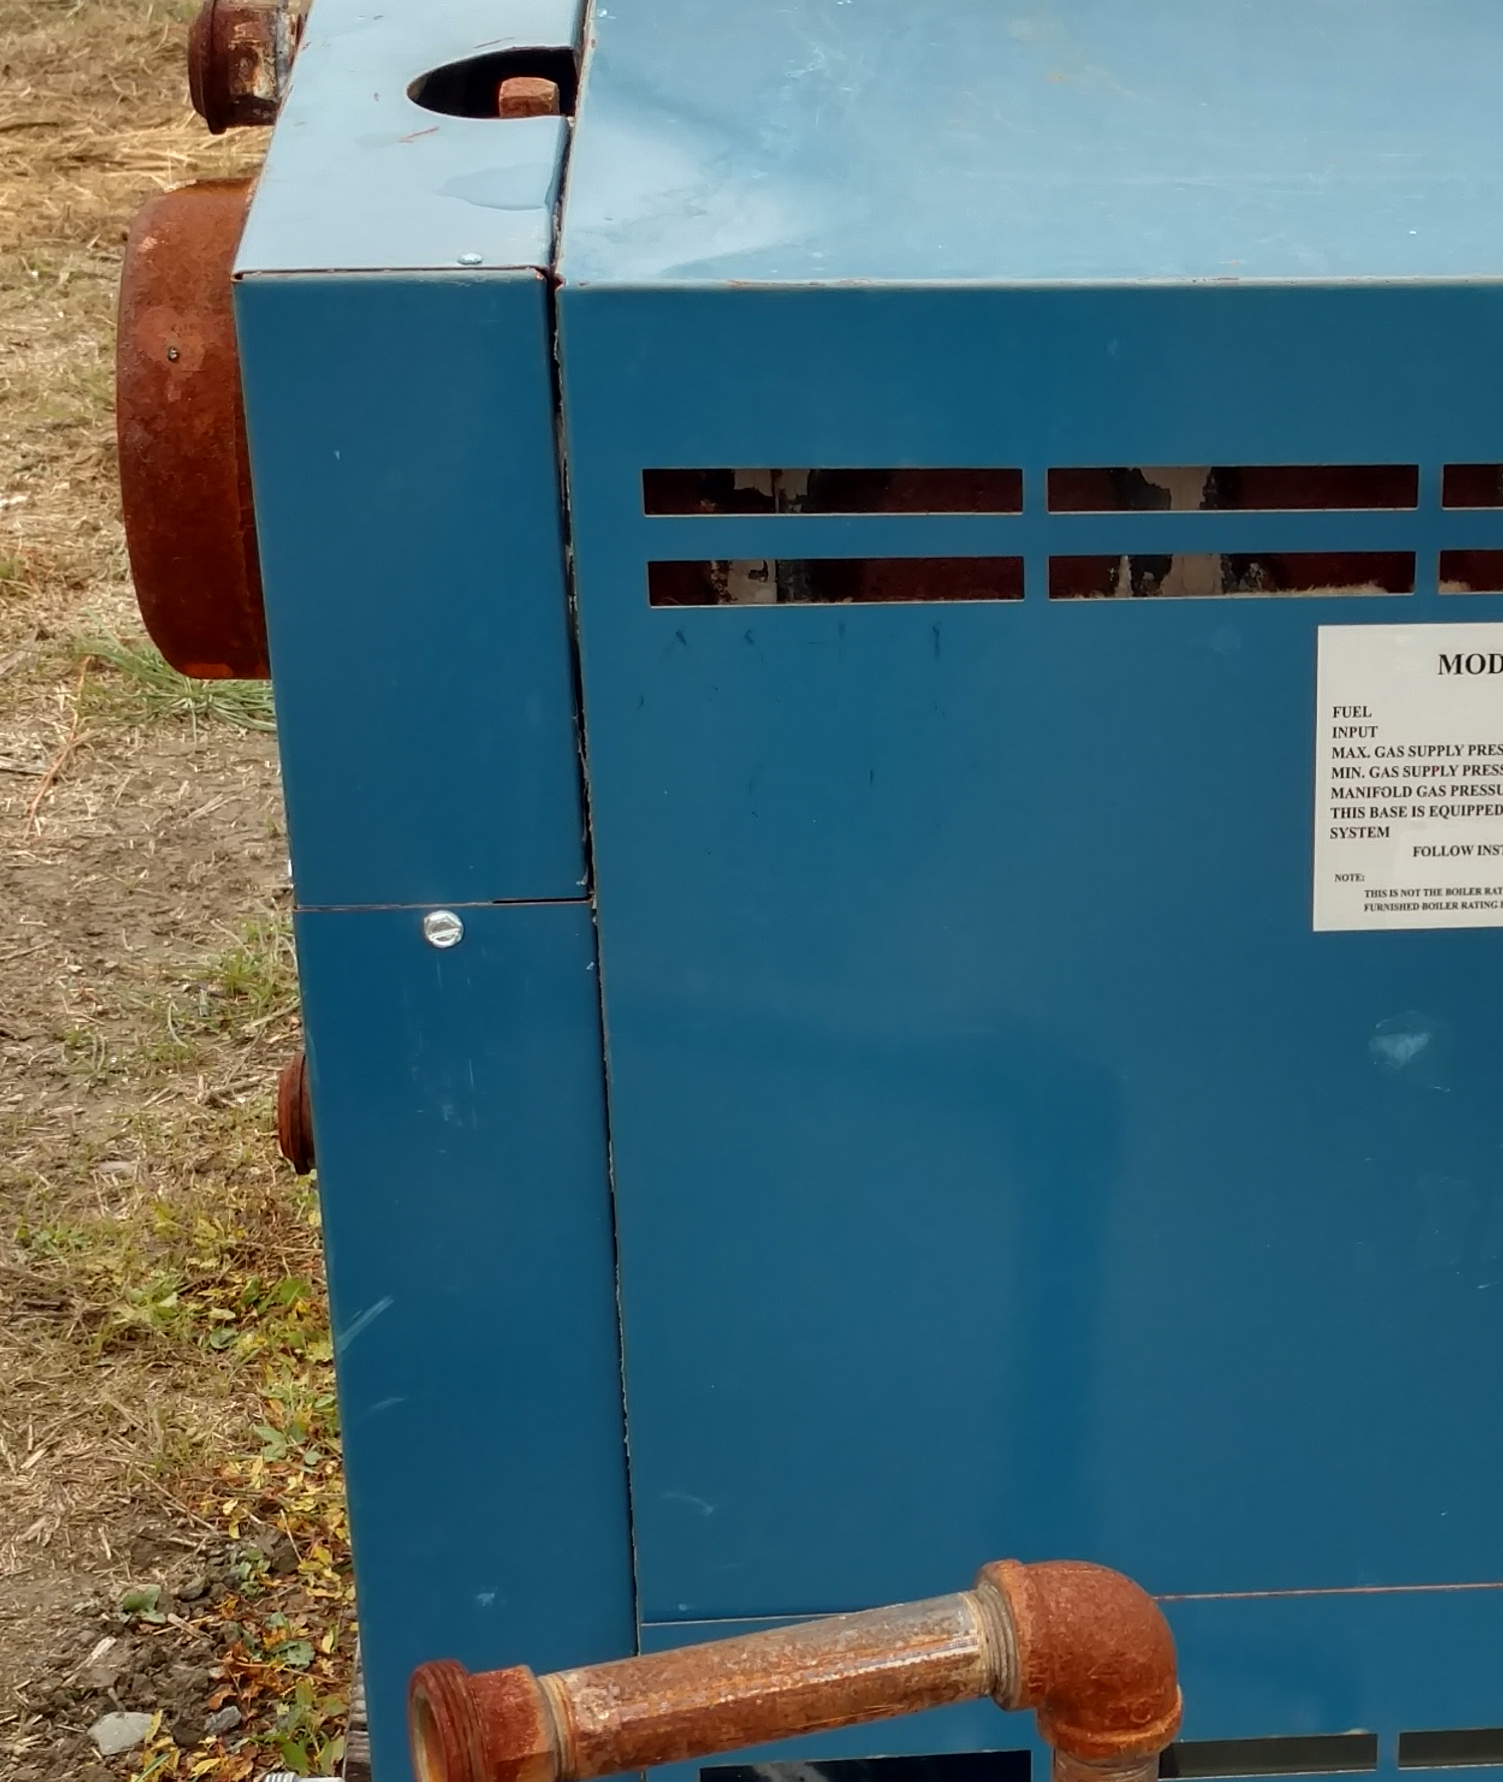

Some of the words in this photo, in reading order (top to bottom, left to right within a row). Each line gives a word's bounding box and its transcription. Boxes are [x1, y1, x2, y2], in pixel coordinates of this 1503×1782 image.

[1333, 706, 1372, 718] FUEL
[1333, 726, 1378, 739] INPUT
[1332, 746, 1370, 759] MAX.
[1374, 746, 1405, 758] GAS
[1408, 745, 1464, 757] SUPPLY
[1332, 767, 1365, 779] MIN.
[1369, 766, 1399, 778] GAS
[1403, 765, 1459, 778] SUPPLY
[1331, 786, 1412, 799] MANIFOLD
[1416, 785, 1446, 797] GAS
[1330, 807, 1365, 819] THIS
[1370, 806, 1407, 818] BASE
[1412, 806, 1425, 817] IS
[1429, 804, 1503, 819] EQUIPPED
[1330, 826, 1389, 839] SYSTEM
[1413, 845, 1474, 857] FOLLOW
[1364, 890, 1387, 898] THIS
[1389, 889, 1398, 897] IS
[1401, 889, 1421, 897] NOT
[1423, 888, 1442, 897] THE
[1445, 887, 1482, 896] BOILER
[1421, 902, 1458, 910] BOILER
[1461, 900, 1498, 909] RATING
